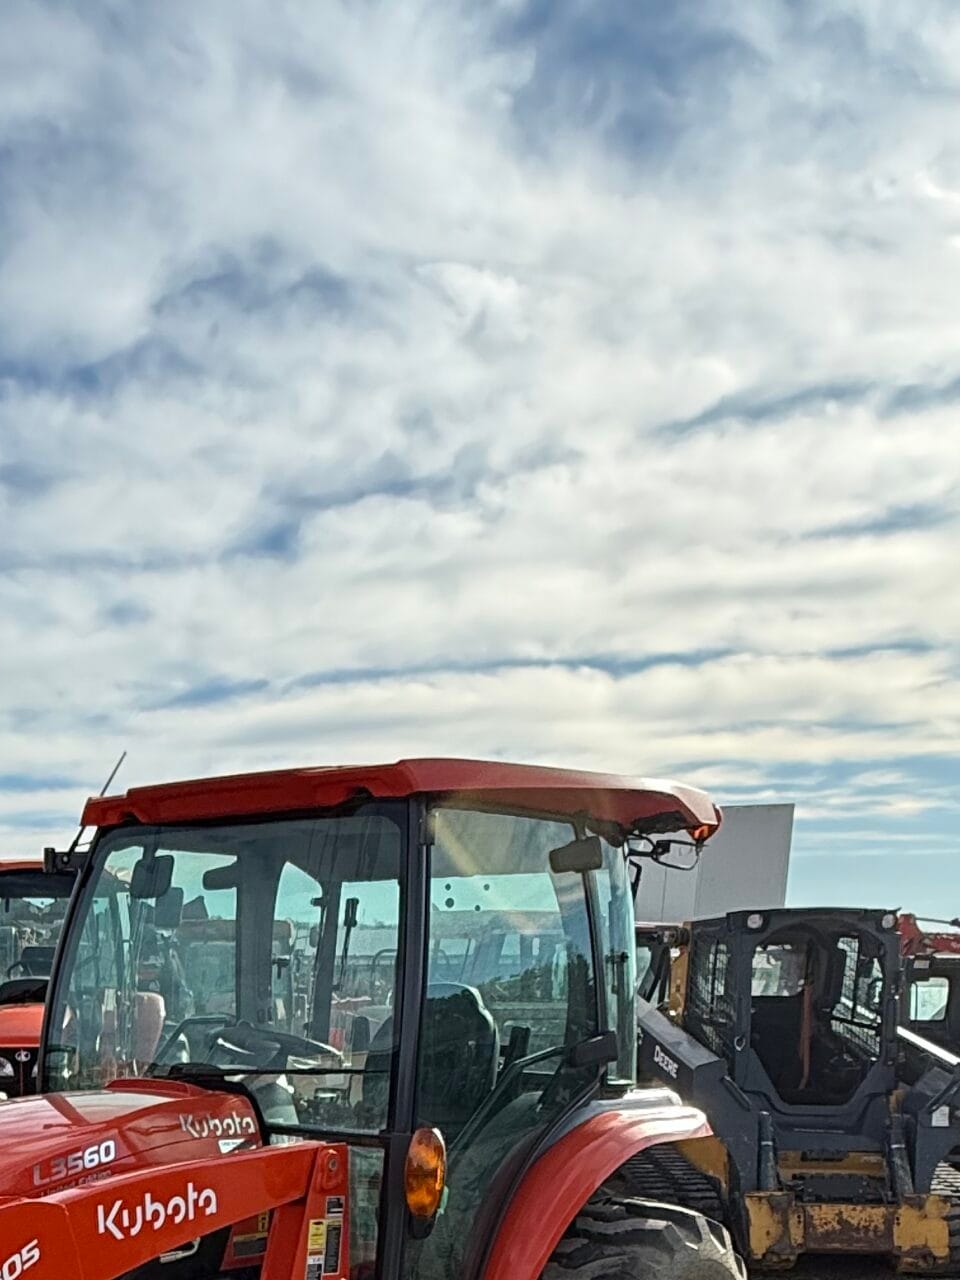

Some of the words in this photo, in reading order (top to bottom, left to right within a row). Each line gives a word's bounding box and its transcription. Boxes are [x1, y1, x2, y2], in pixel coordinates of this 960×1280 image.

[653, 1045, 679, 1078] DEERE
[178, 1111, 256, 1138] Kubota
[32, 1140, 116, 1186] L3560
[97, 1182, 218, 1241] Kubota
